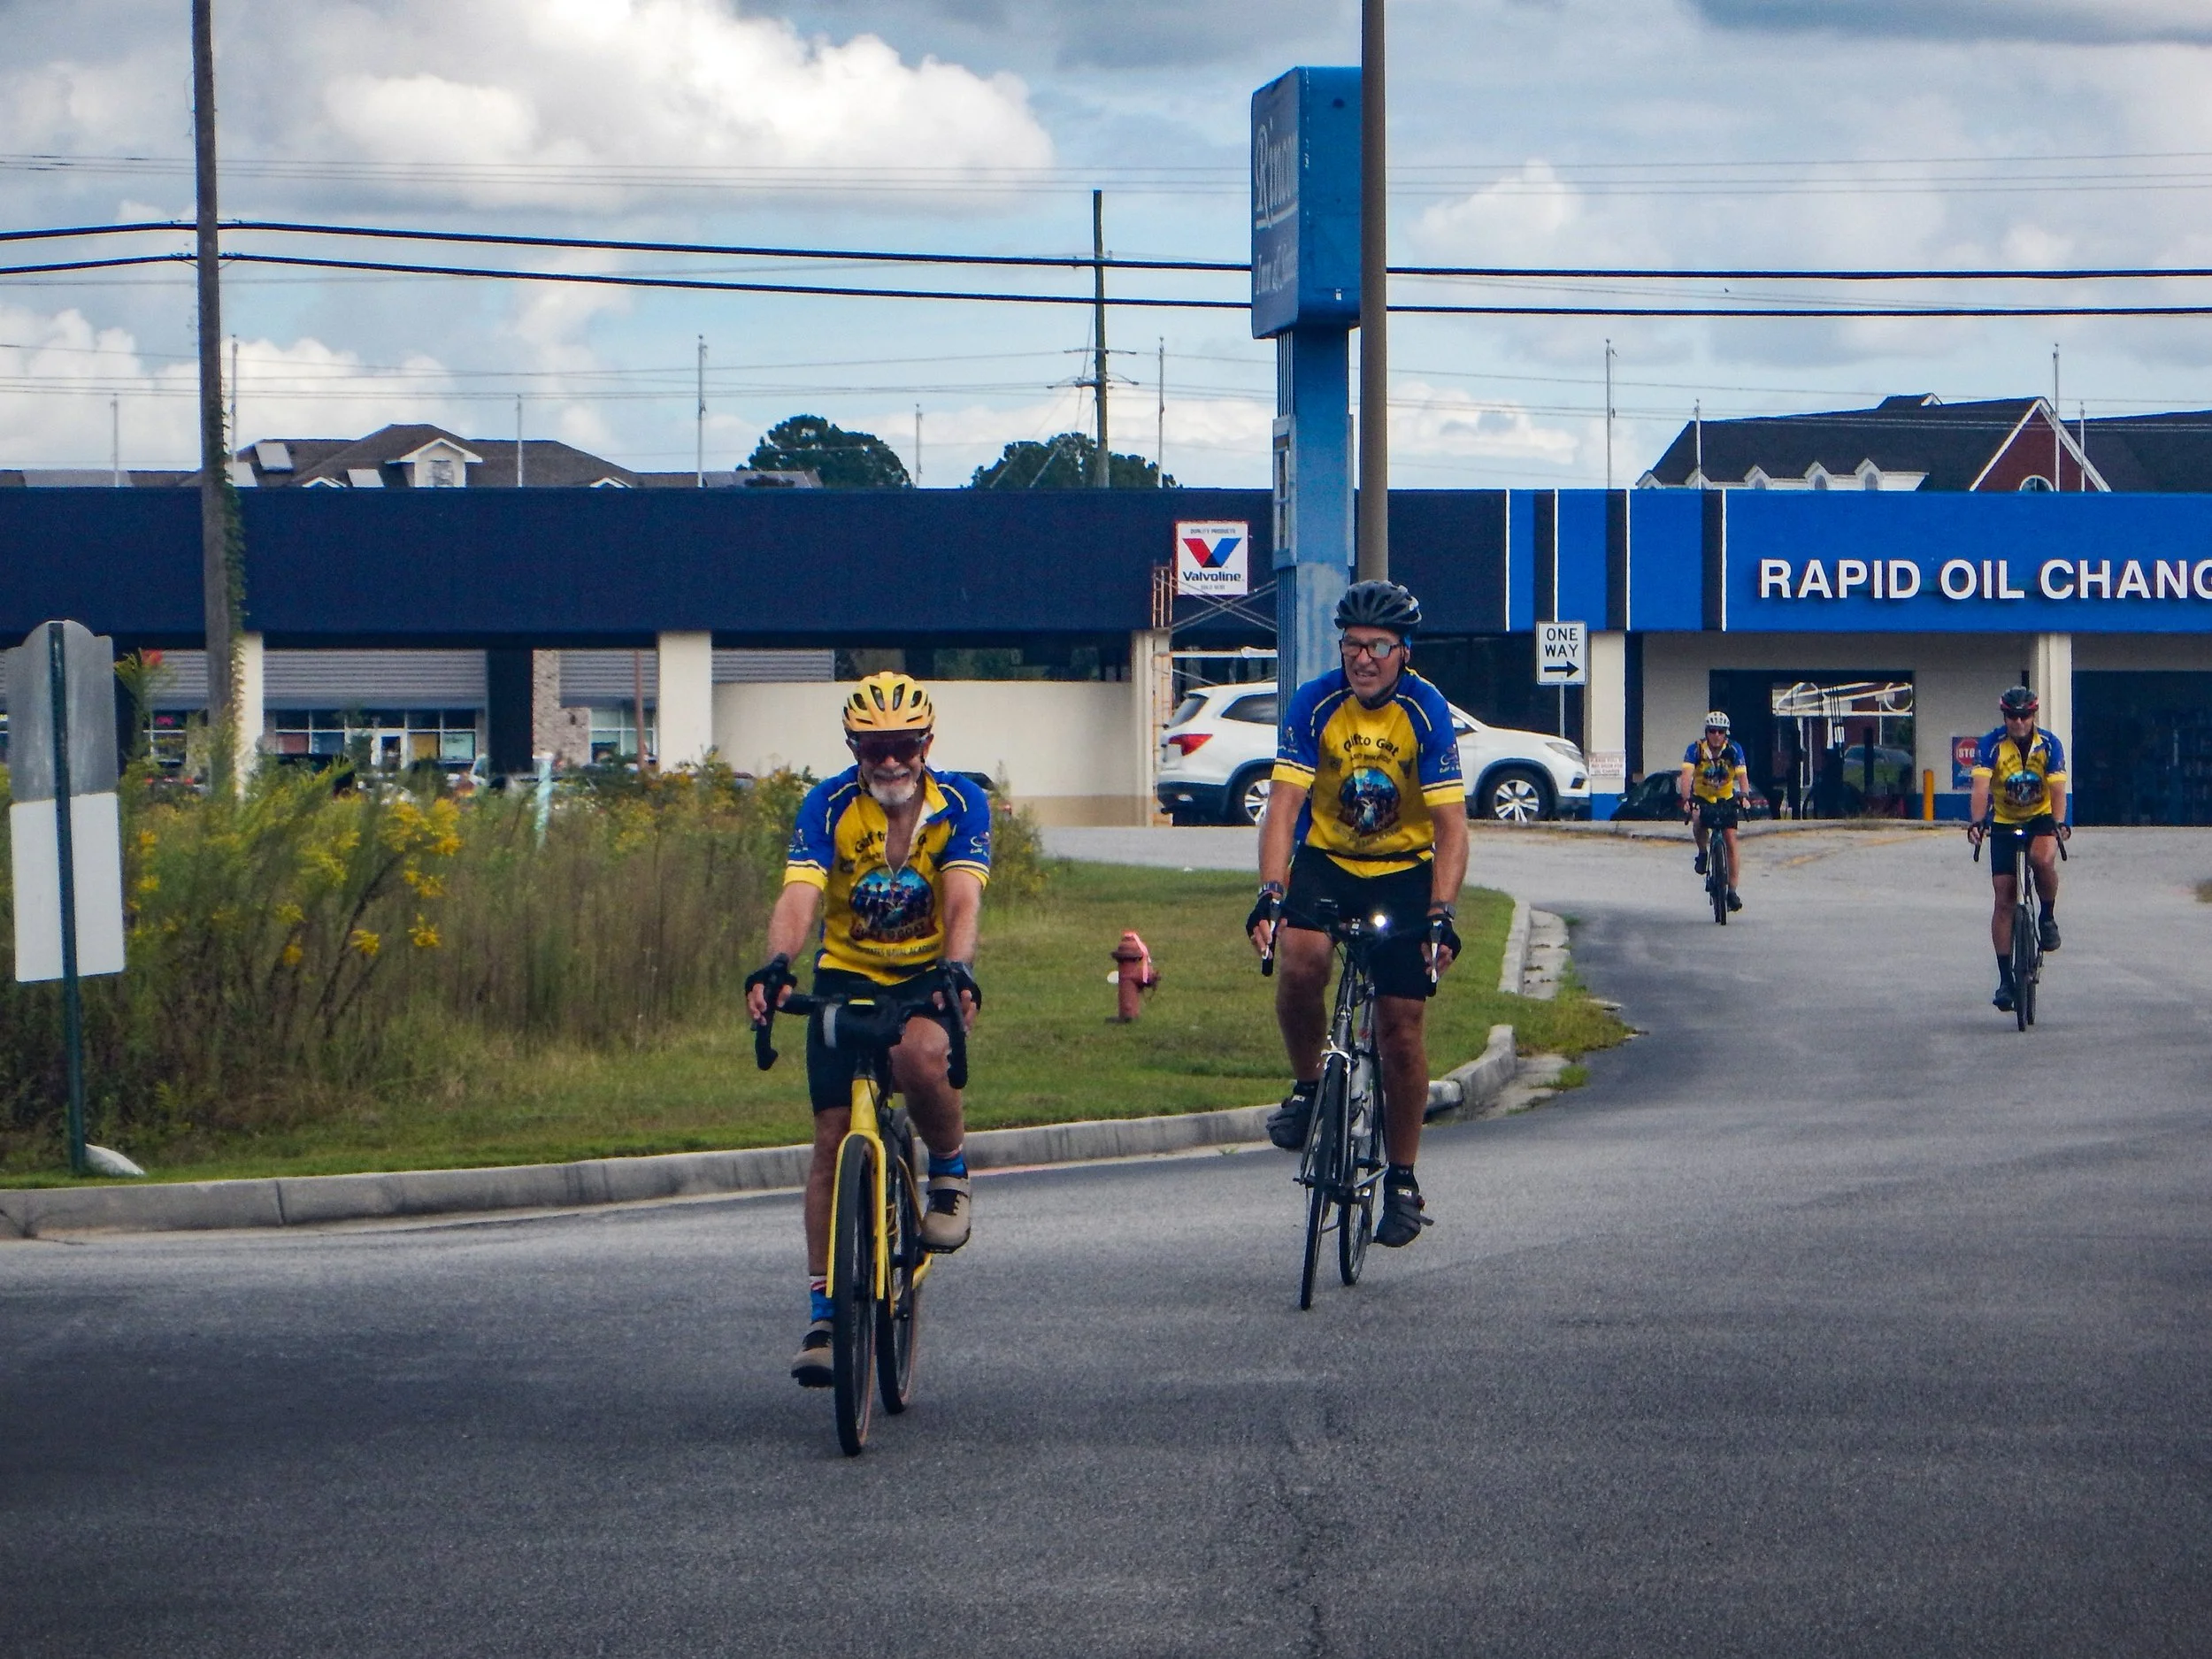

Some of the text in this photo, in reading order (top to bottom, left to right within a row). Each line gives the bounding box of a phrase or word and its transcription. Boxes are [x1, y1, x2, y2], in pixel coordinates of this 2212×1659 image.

[1182, 572, 1241, 581] Valvoline
[1760, 558, 1921, 599] RAPID
[1939, 558, 2025, 600] OIL
[1546, 627, 1578, 641] ONE
[1544, 643, 1578, 657] WAY
[1957, 748, 1976, 758] STO
